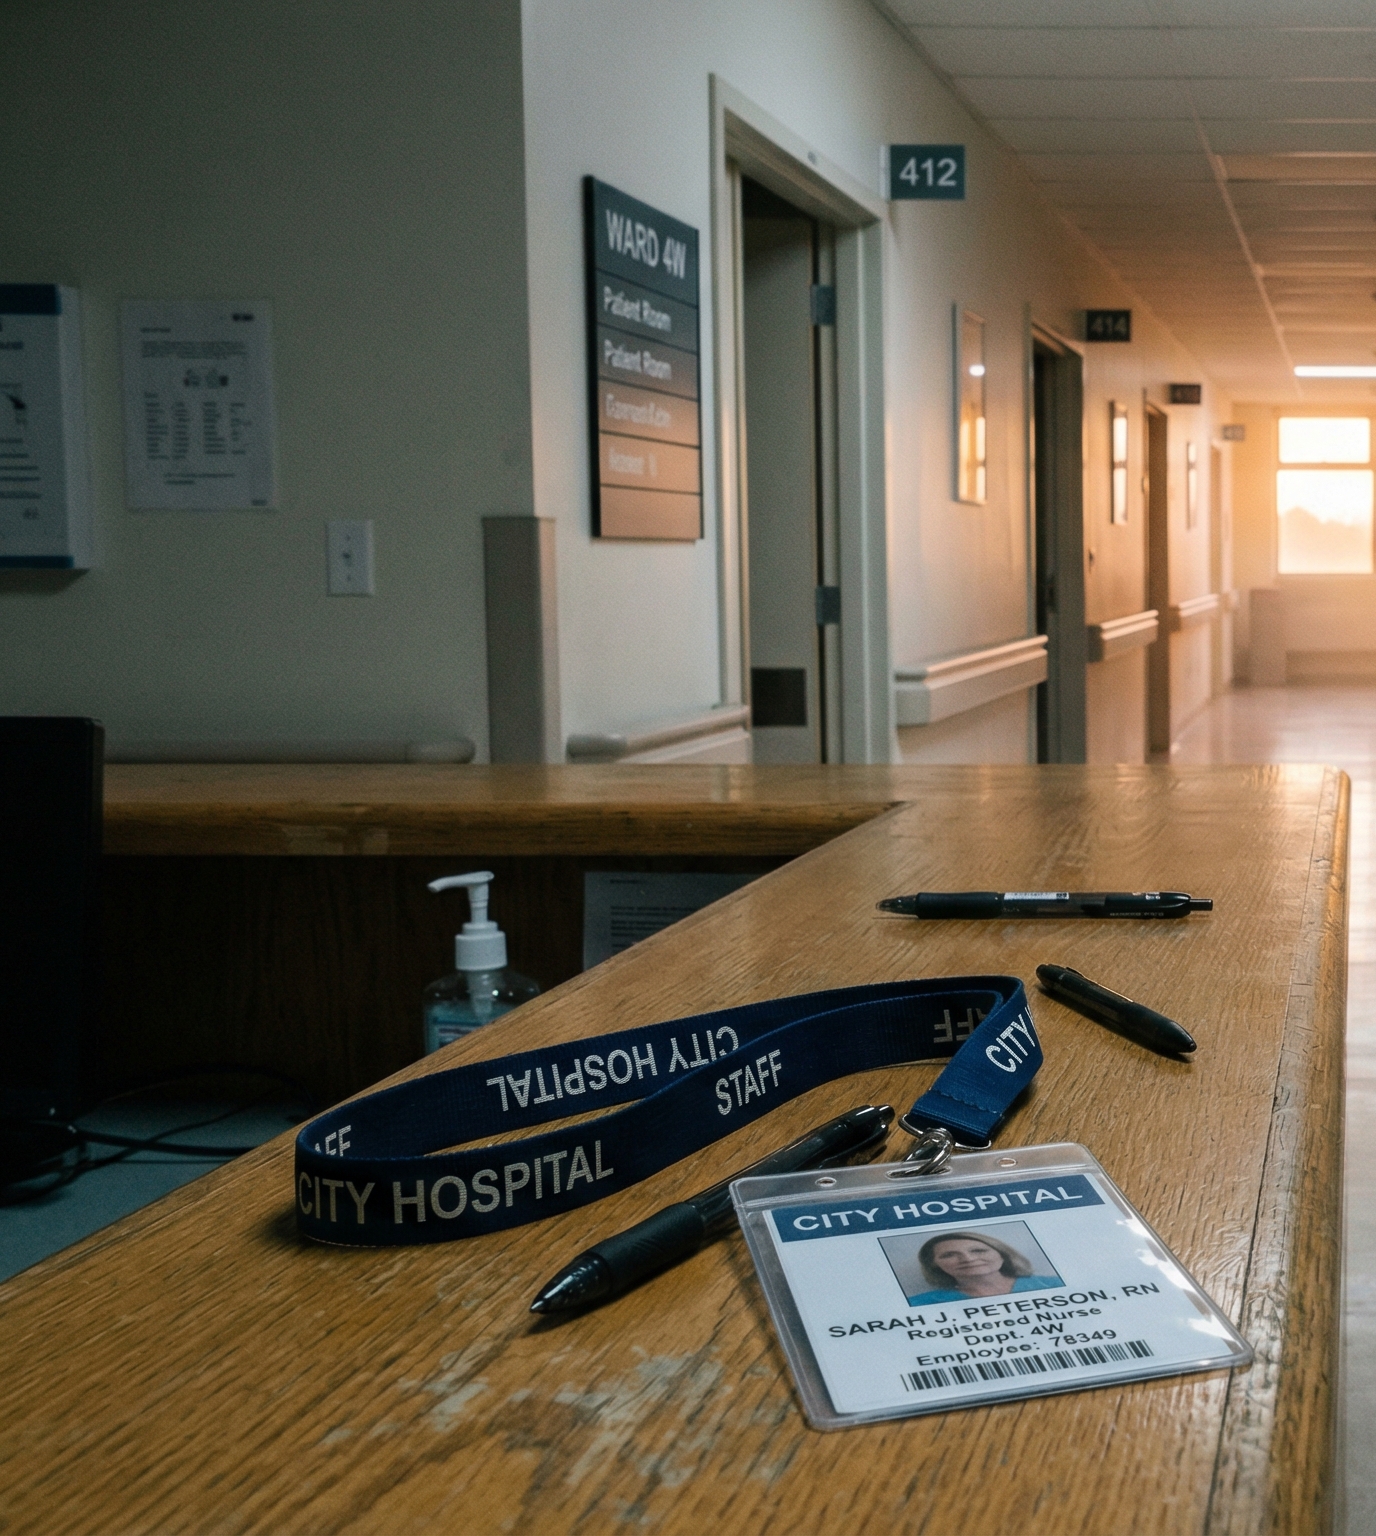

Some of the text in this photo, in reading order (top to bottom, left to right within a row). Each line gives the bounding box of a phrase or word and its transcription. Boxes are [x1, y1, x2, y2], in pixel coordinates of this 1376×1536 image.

[900, 157, 957, 187] 412
[606, 209, 686, 280] WARD 4W
[603, 285, 672, 332] Patient Room
[1090, 315, 1128, 336] 414
[603, 339, 672, 380] Patient Room
[985, 1014, 1036, 1073] CITY
[486, 1025, 740, 1112] CITY HOSPITAL
[715, 1049, 783, 1116] STAFF
[298, 1140, 614, 1225] CITY HOSPITAL
[793, 1186, 1083, 1232] CITY HOSPITAL
[828, 1282, 1161, 1338] SARAH J. PETERSON, RN
[907, 1306, 1102, 1341] Registered Nurse
[916, 1328, 1117, 1367] Employee: 78349
[963, 1322, 1066, 1349] Dept. 4W
